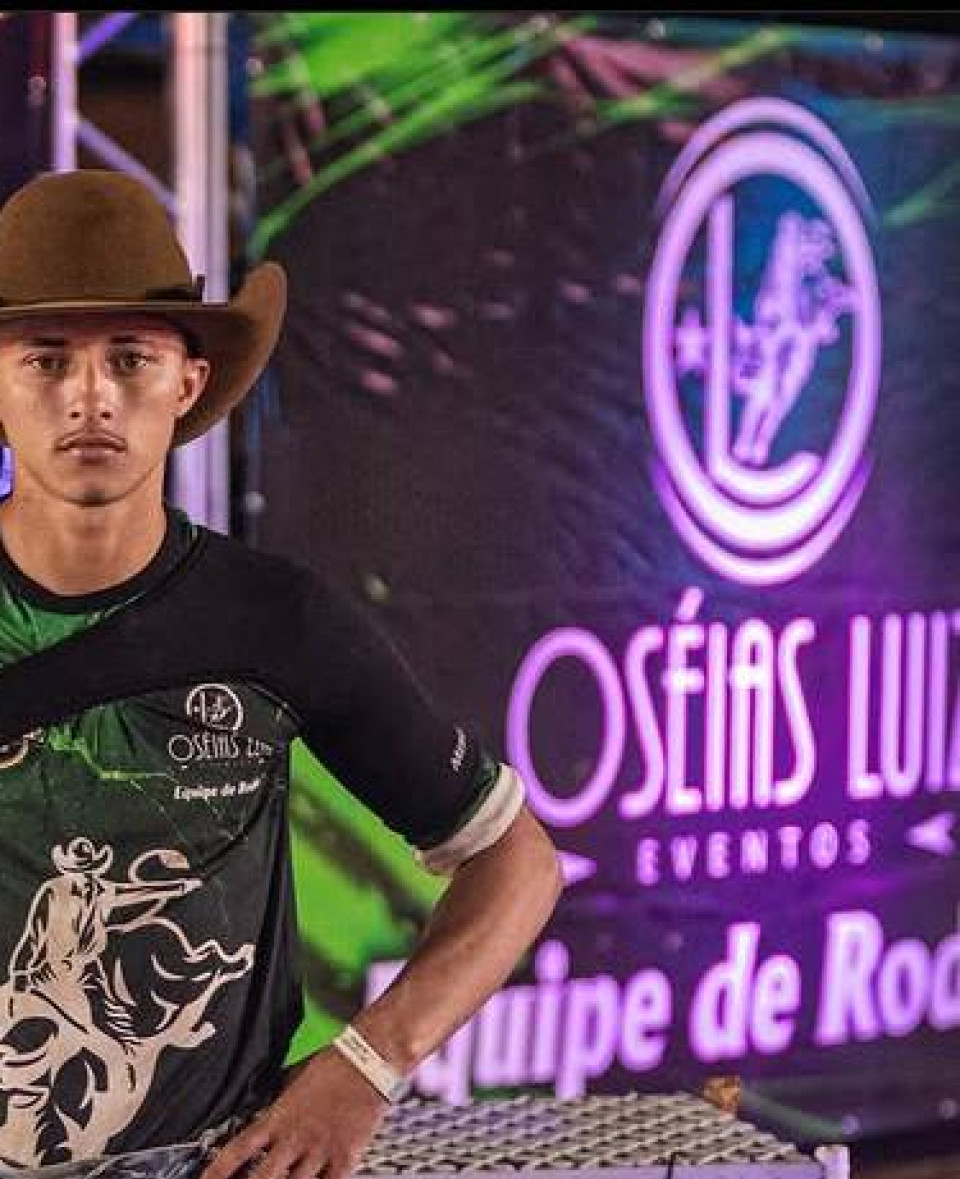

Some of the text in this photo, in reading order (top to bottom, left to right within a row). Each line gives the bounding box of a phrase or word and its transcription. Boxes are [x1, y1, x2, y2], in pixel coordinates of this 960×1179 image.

[507, 586, 817, 826] OSÉIAS
[637, 818, 872, 884] EVENTOS
[687, 922, 801, 1062] de
